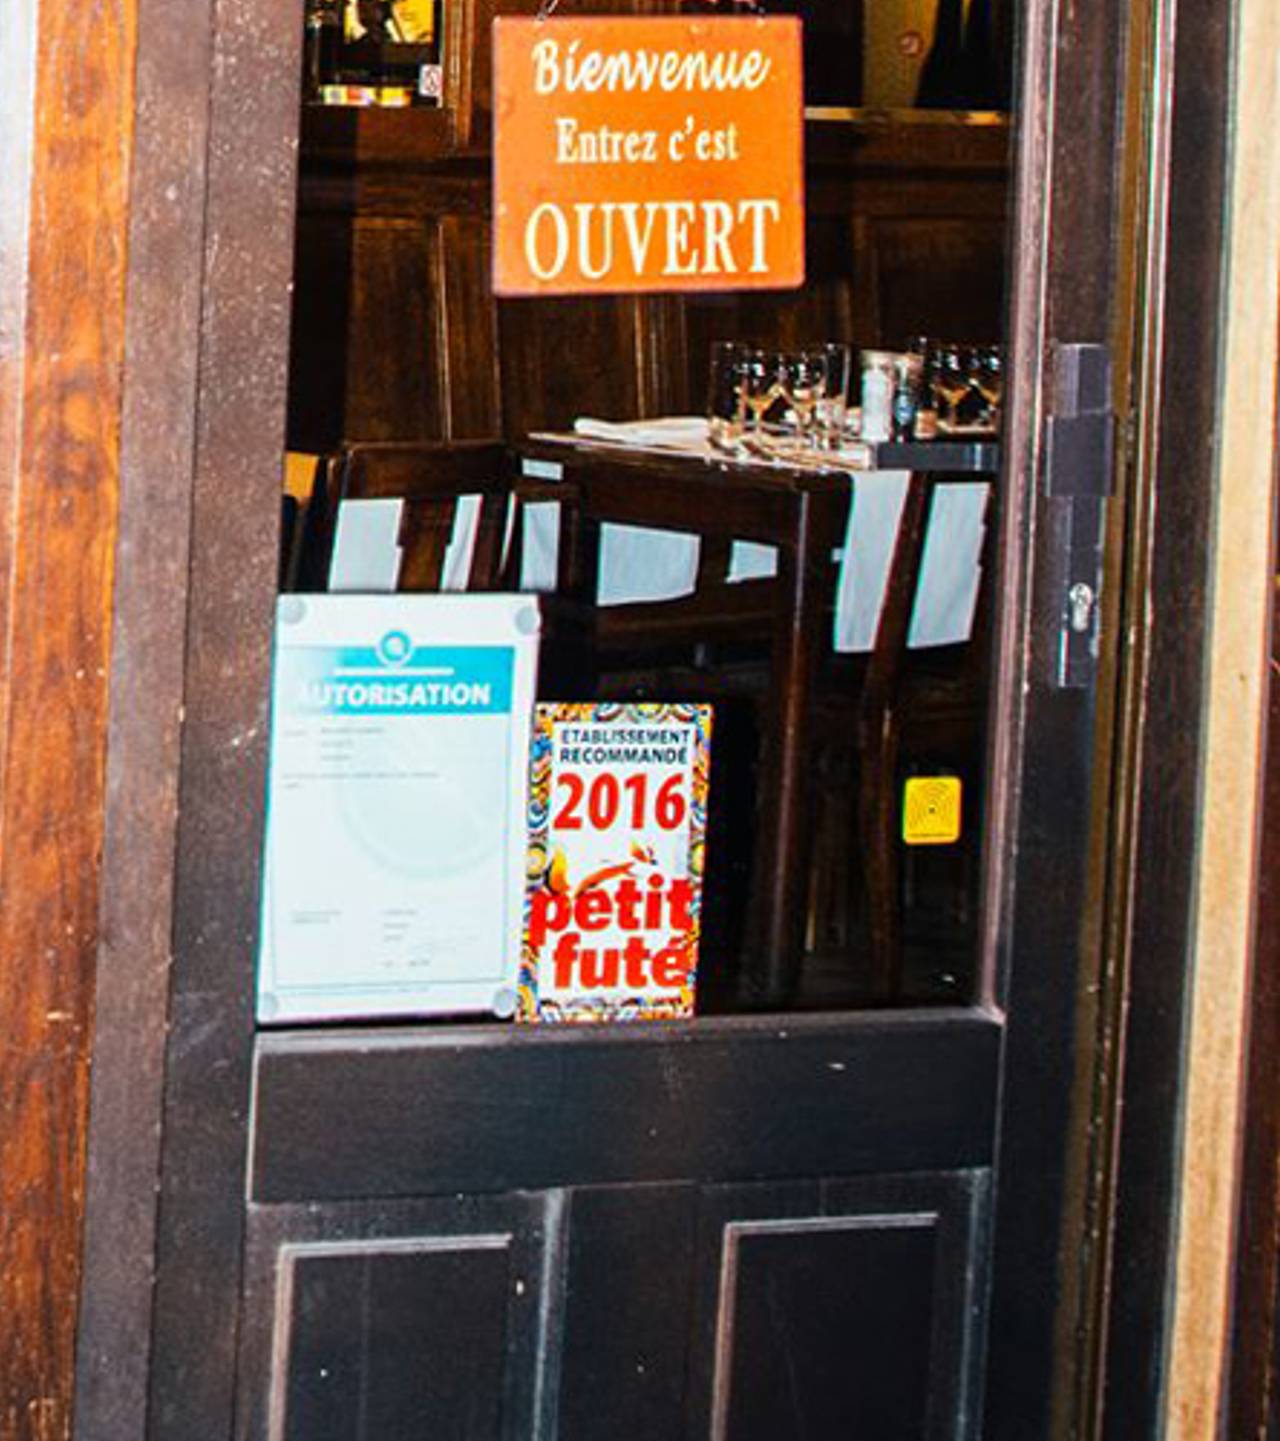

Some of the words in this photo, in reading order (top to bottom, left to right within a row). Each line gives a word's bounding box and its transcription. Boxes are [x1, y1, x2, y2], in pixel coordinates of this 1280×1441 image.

[532, 41, 772, 95] Bienvenue
[557, 117, 659, 164] Entrez
[669, 116, 739, 163] c'est
[524, 199, 780, 280] OUVERT
[298, 681, 491, 707] UTORISATION
[559, 746, 689, 765] RECOMMANDÉ
[553, 772, 687, 831] 2016
[528, 873, 694, 946] petit
[553, 932, 690, 989] futé
